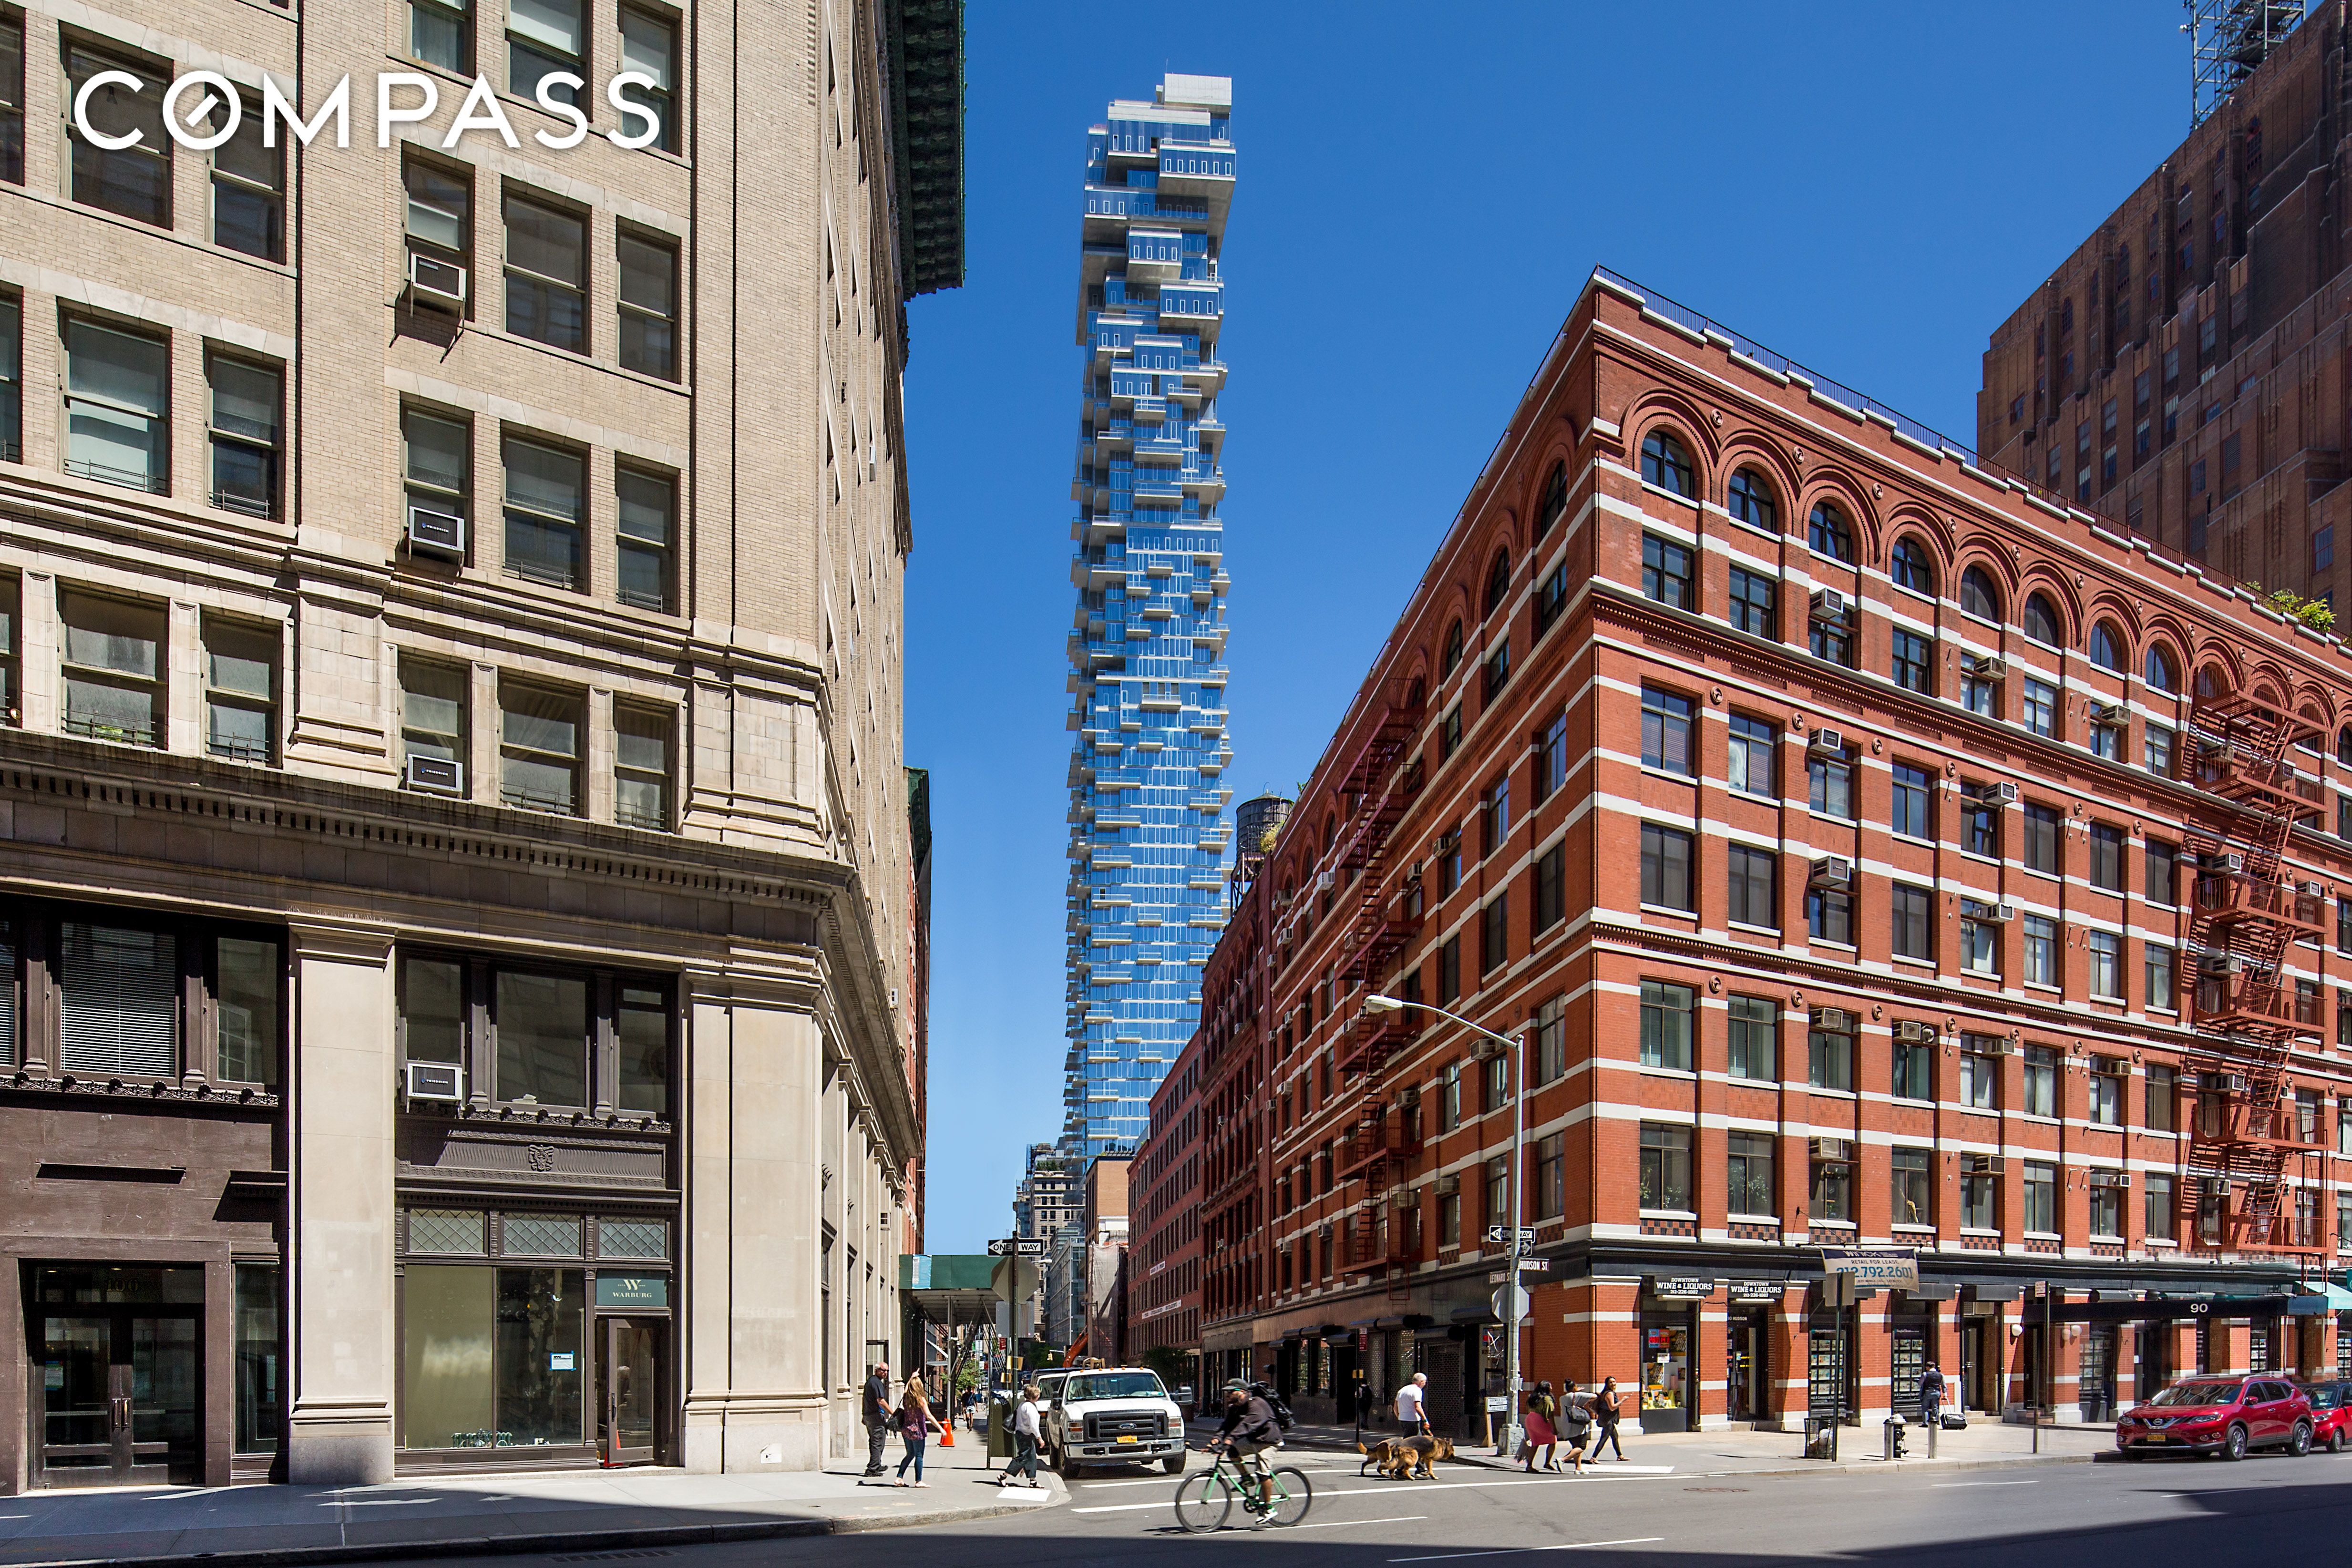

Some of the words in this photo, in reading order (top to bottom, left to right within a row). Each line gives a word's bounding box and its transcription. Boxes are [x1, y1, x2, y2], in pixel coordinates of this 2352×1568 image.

[1520, 1260, 1540, 1270] HUDSON
[1541, 1261, 1548, 1271] ST
[1490, 1273, 1506, 1283] LEONARD
[106, 1279, 138, 1292] 100
[2190, 1303, 2208, 1313] 90
